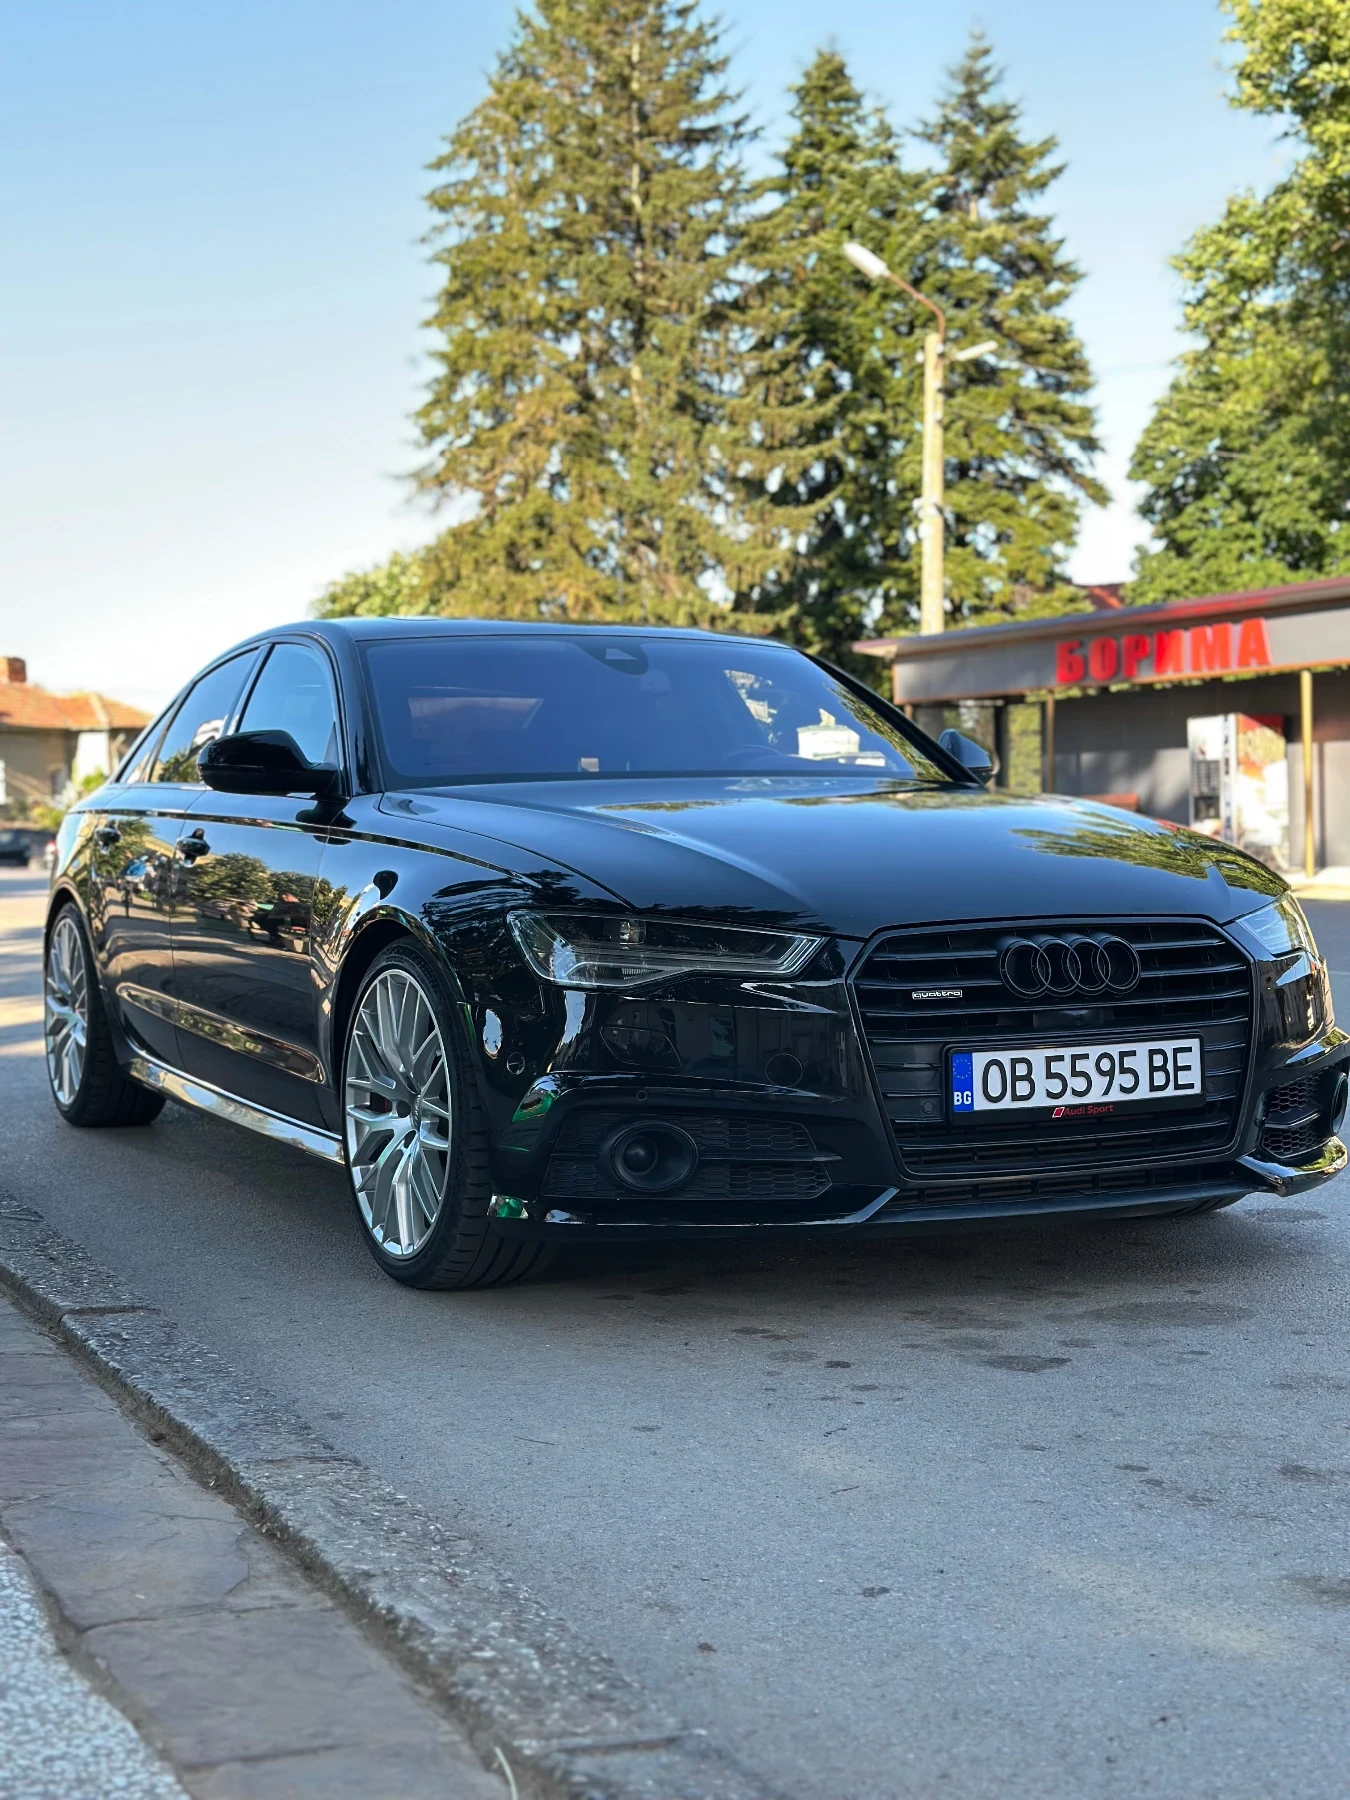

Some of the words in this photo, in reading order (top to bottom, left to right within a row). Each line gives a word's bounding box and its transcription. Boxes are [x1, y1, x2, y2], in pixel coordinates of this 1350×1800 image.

[1056, 617, 1271, 683] БОРИМА
[913, 990, 961, 999] quattro
[1045, 1050, 1140, 1099] 5595
[1148, 1047, 1195, 1092] BE
[953, 1091, 972, 1105] BG
[1064, 1106, 1086, 1116] Audi
[1087, 1104, 1114, 1115] Sport
